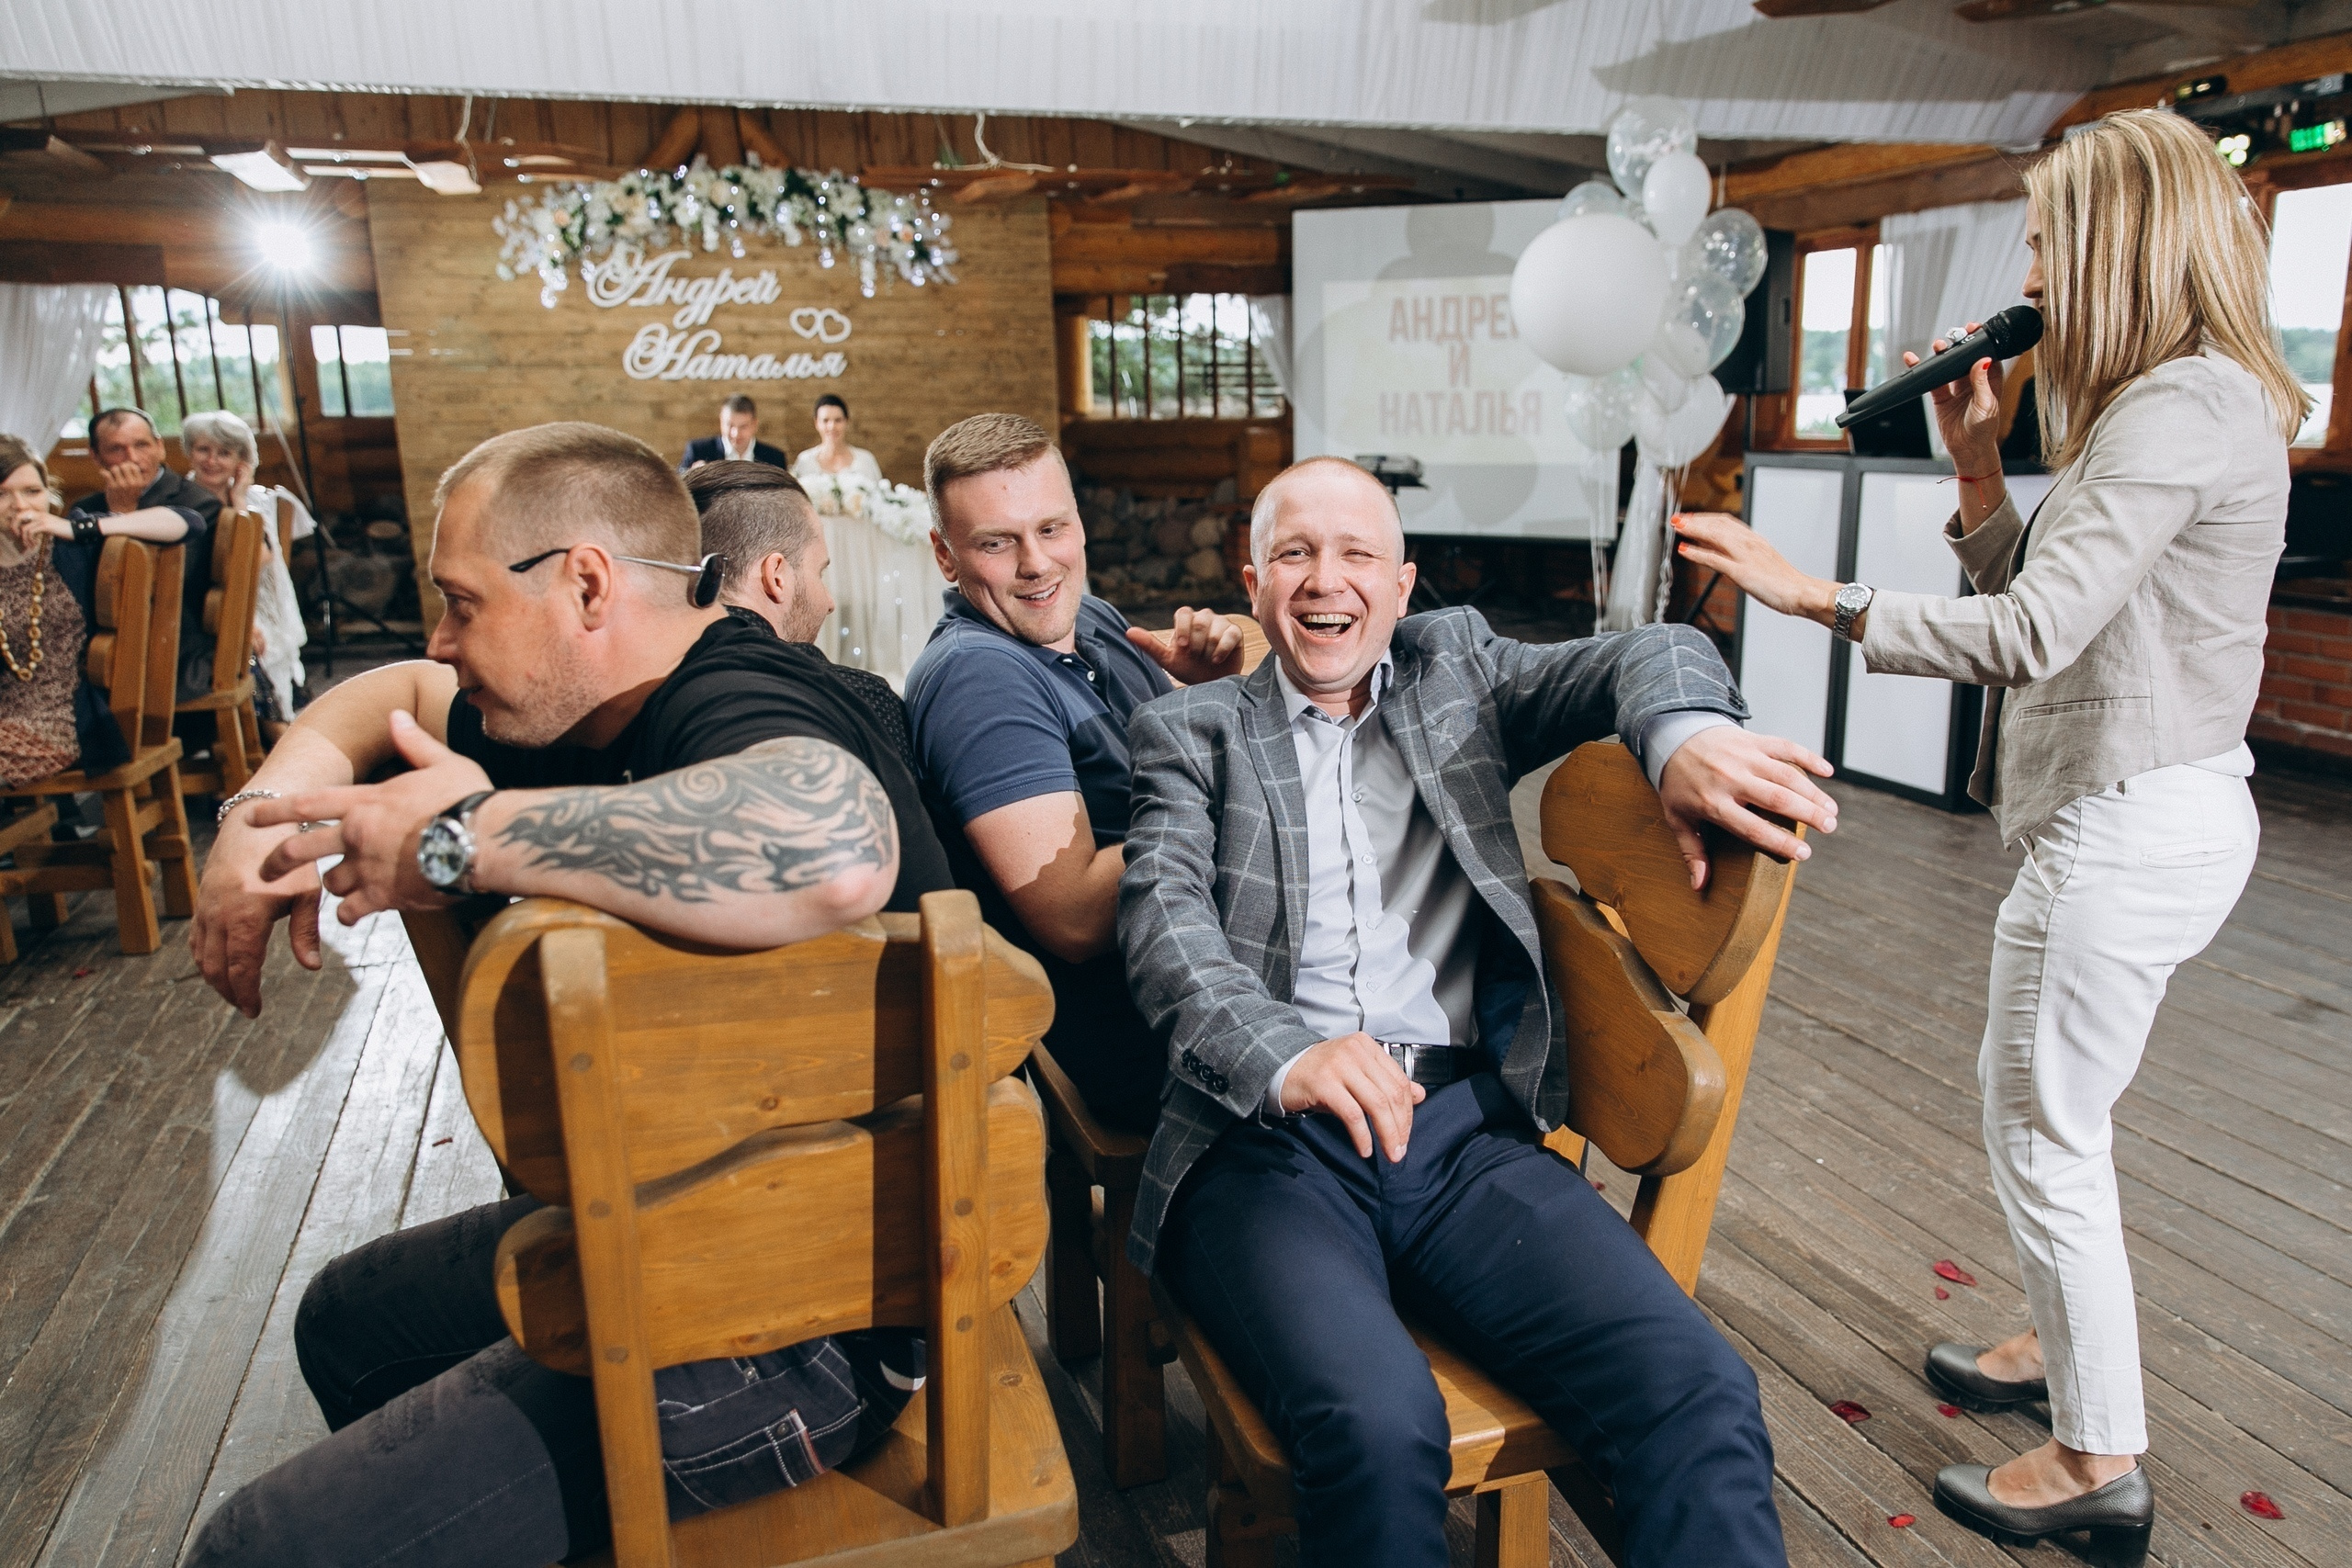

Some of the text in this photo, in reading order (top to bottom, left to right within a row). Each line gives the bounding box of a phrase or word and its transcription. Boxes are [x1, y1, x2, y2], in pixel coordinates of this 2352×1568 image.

[585, 242, 781, 329] Андрей
[1388, 294, 1519, 344] АНДРЕ
[623, 322, 847, 380] Наталья
[1448, 342, 1471, 387] И
[1379, 389, 1543, 435] НАТАЛЬЯ
